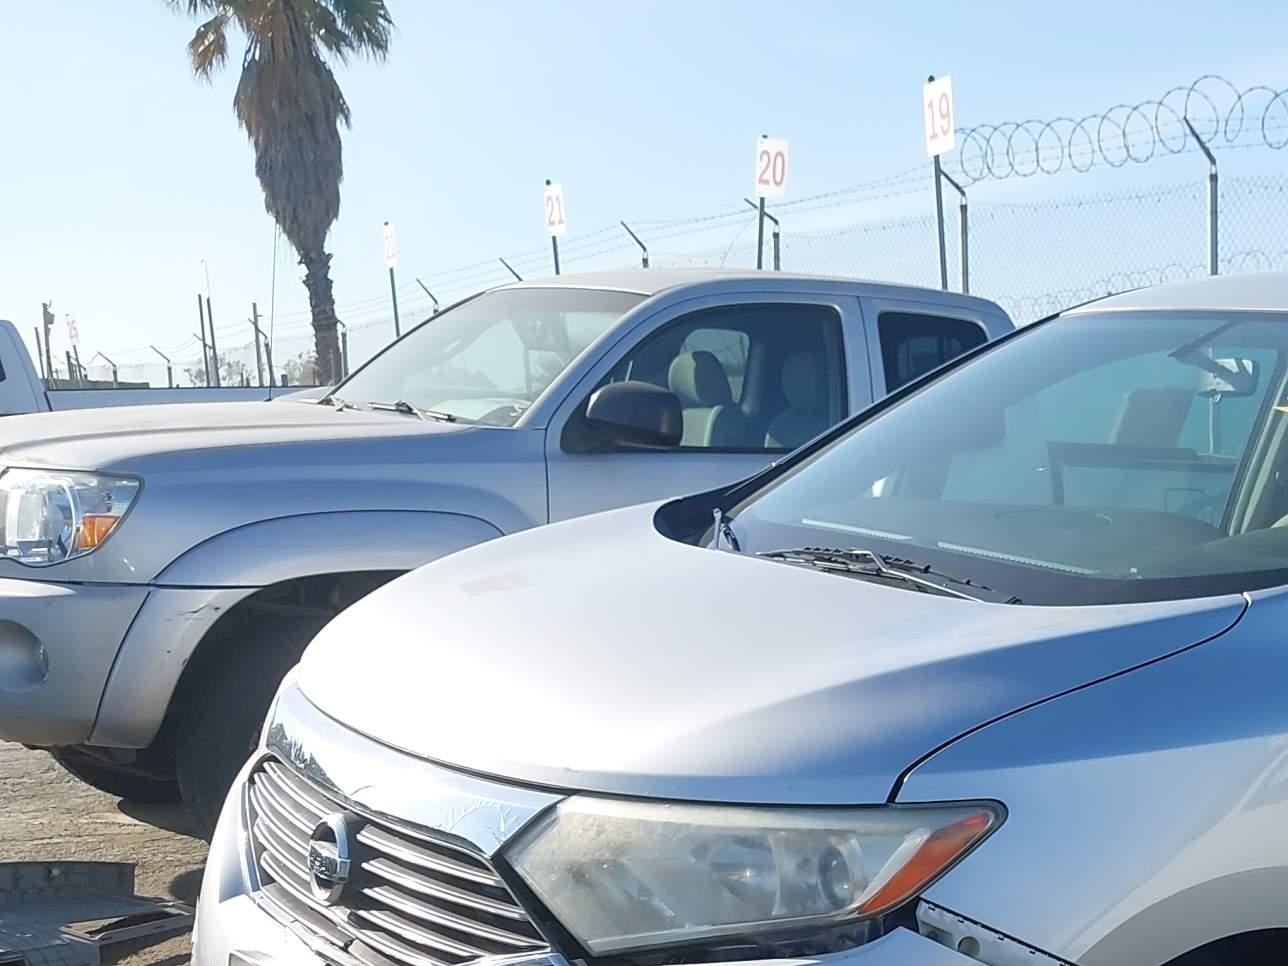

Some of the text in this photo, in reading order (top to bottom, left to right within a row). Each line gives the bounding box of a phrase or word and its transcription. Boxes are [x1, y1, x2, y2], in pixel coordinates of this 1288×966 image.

[927, 92, 951, 141] 19
[758, 149, 786, 187] 20
[545, 193, 564, 227] 21
